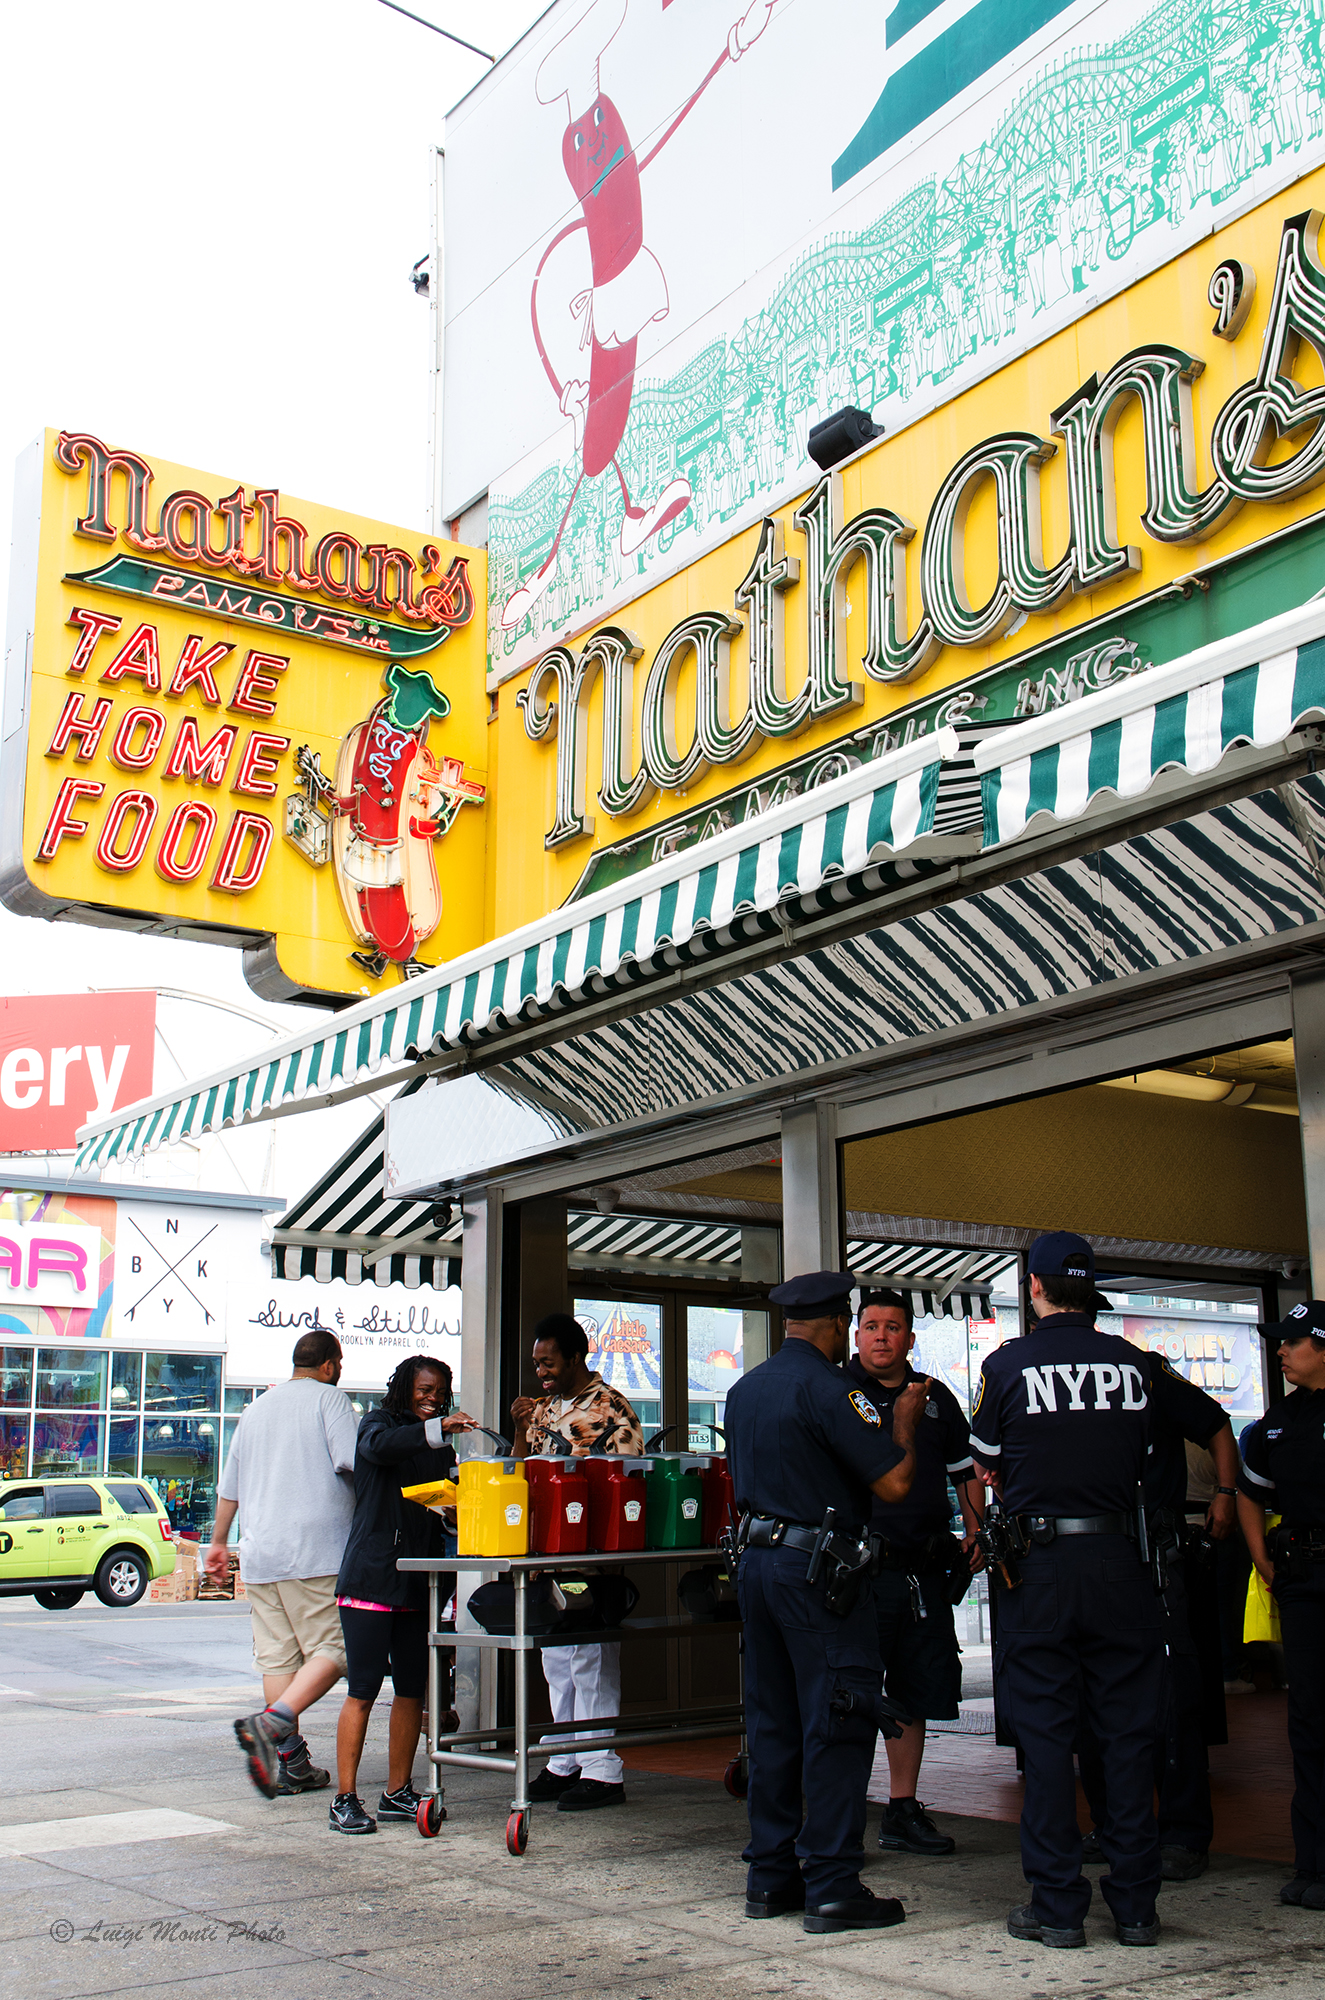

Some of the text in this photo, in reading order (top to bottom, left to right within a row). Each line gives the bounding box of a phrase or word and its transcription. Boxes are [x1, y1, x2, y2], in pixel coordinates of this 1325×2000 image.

[65, 606, 291, 718] TAKE
[44, 691, 292, 798] HOME
[34, 776, 275, 896] FOOD
[0, 1042, 131, 1123] ery
[166, 1218, 179, 1234] N
[1067, 1267, 1086, 1277] NYPD
[163, 1298, 174, 1313] Y
[335, 1307, 346, 1330] &
[611, 1318, 647, 1338] Little
[337, 1335, 374, 1346] ROOKLYN
[378, 1336, 411, 1348] APPAREL
[601, 1333, 651, 1354] Caesars
[1147, 1333, 1237, 1362] CONEY
[1021, 1363, 1148, 1415] NYPD
[688, 1434, 710, 1444] ITES
